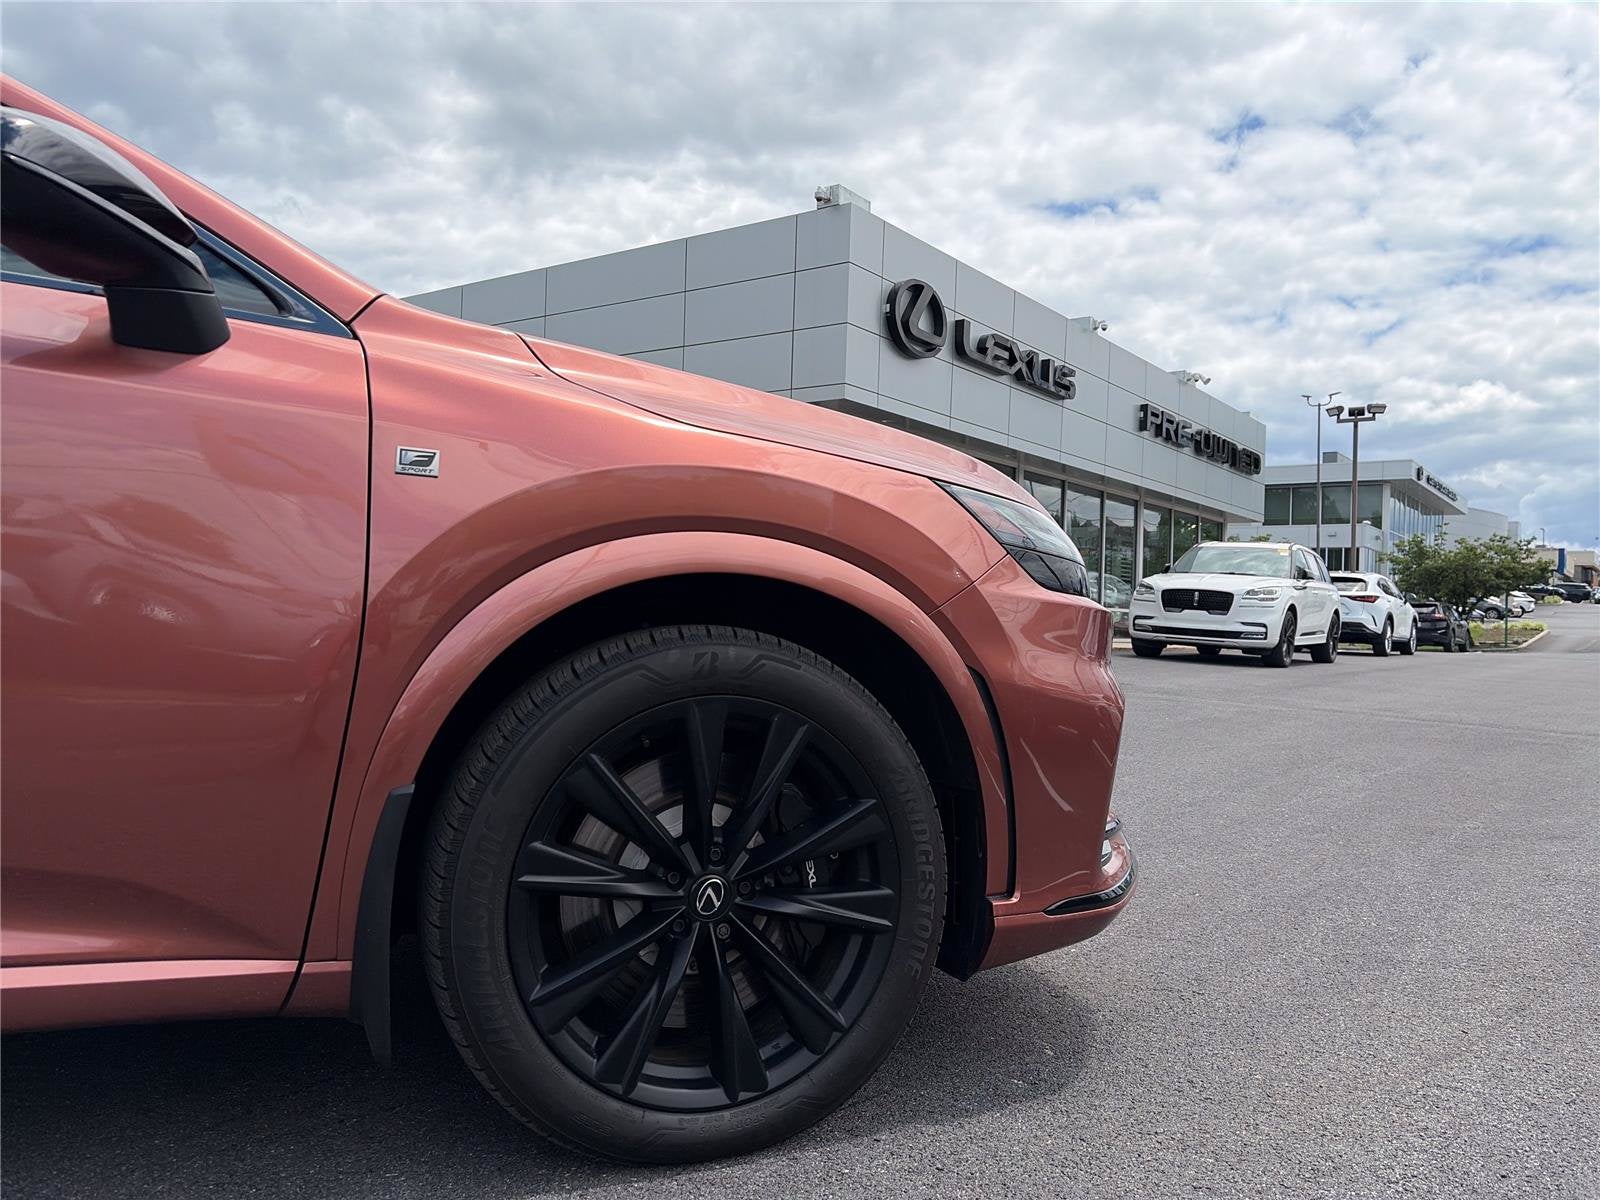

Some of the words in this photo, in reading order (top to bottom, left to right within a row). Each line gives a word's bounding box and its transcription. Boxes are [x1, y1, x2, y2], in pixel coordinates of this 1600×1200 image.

[955, 318, 1076, 400] LEXUS
[400, 466, 435, 474] SPORT
[1139, 403, 1262, 475] PRE-OWNED
[888, 767, 936, 980] BRIDGESTONE
